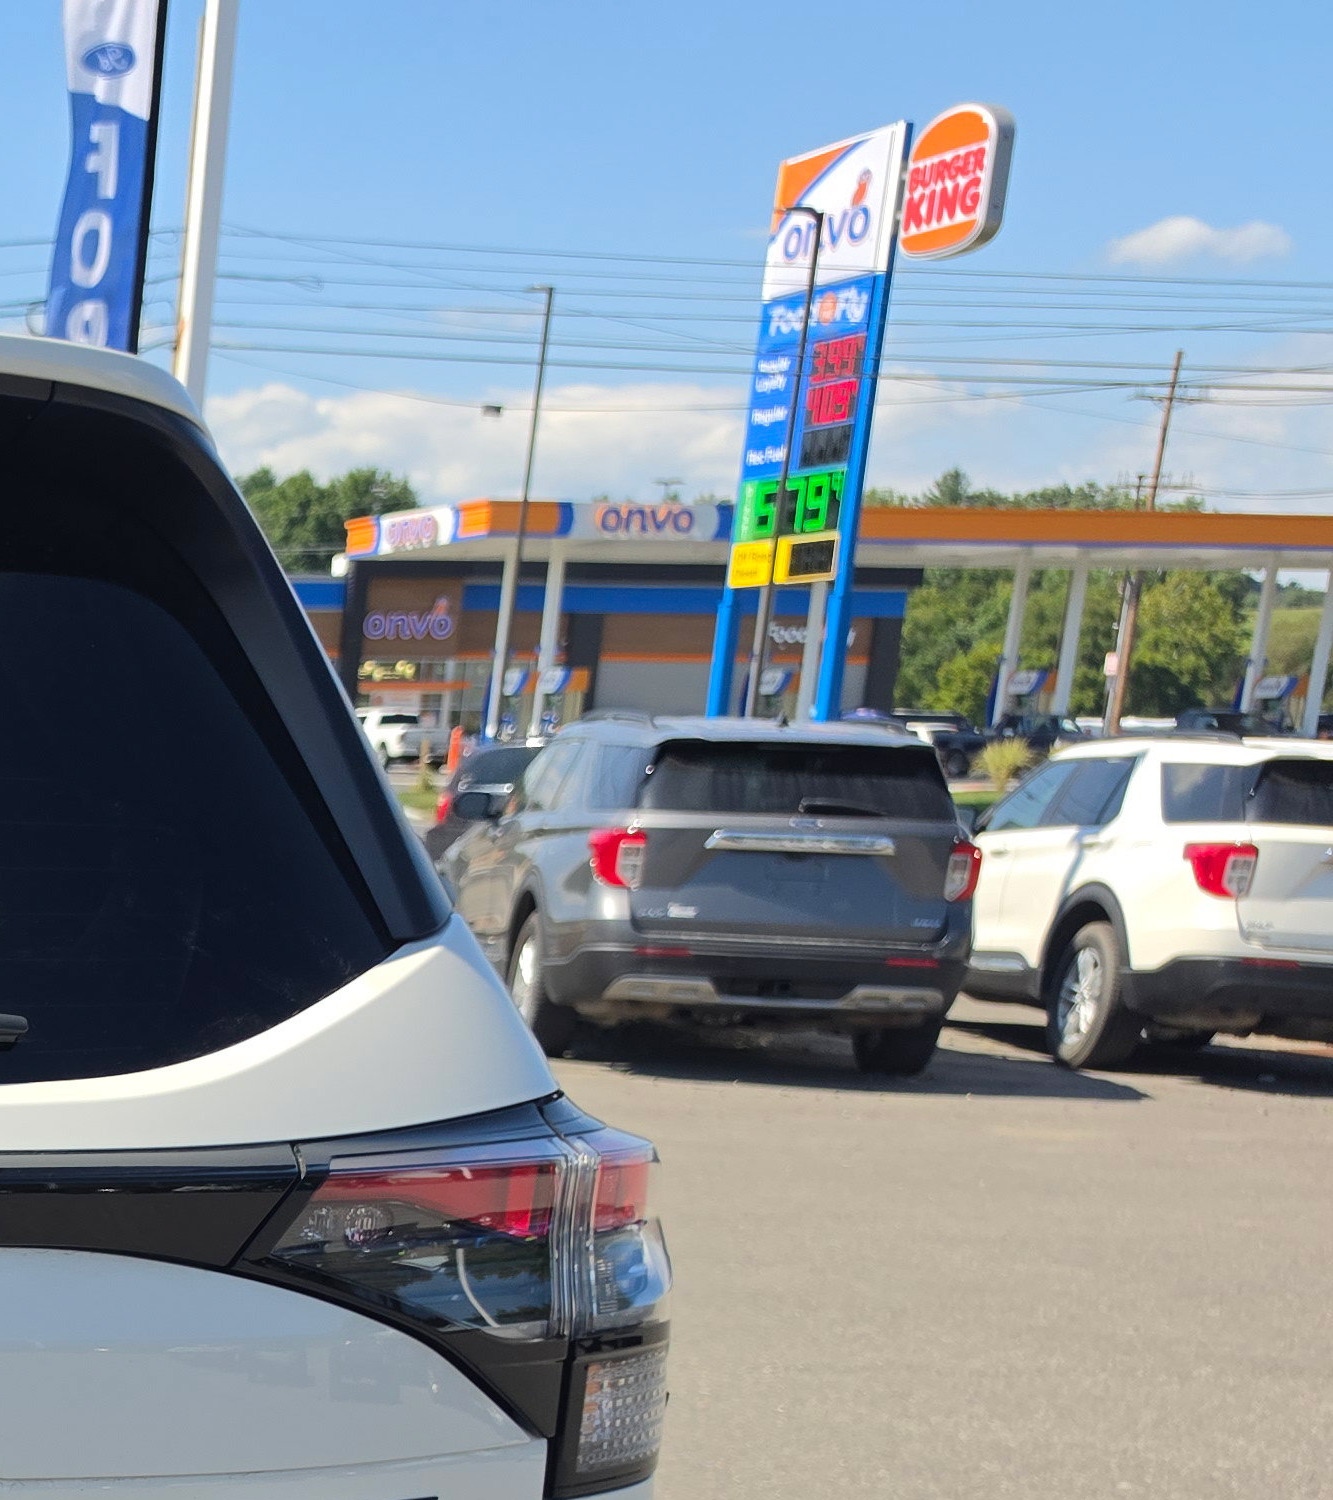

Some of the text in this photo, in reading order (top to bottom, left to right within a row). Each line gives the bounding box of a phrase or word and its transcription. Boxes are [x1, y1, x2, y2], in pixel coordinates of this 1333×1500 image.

[909, 147, 986, 194] BURGER
[903, 177, 981, 232] KING
[595, 504, 695, 533] onvo
[363, 609, 452, 640] onvo
